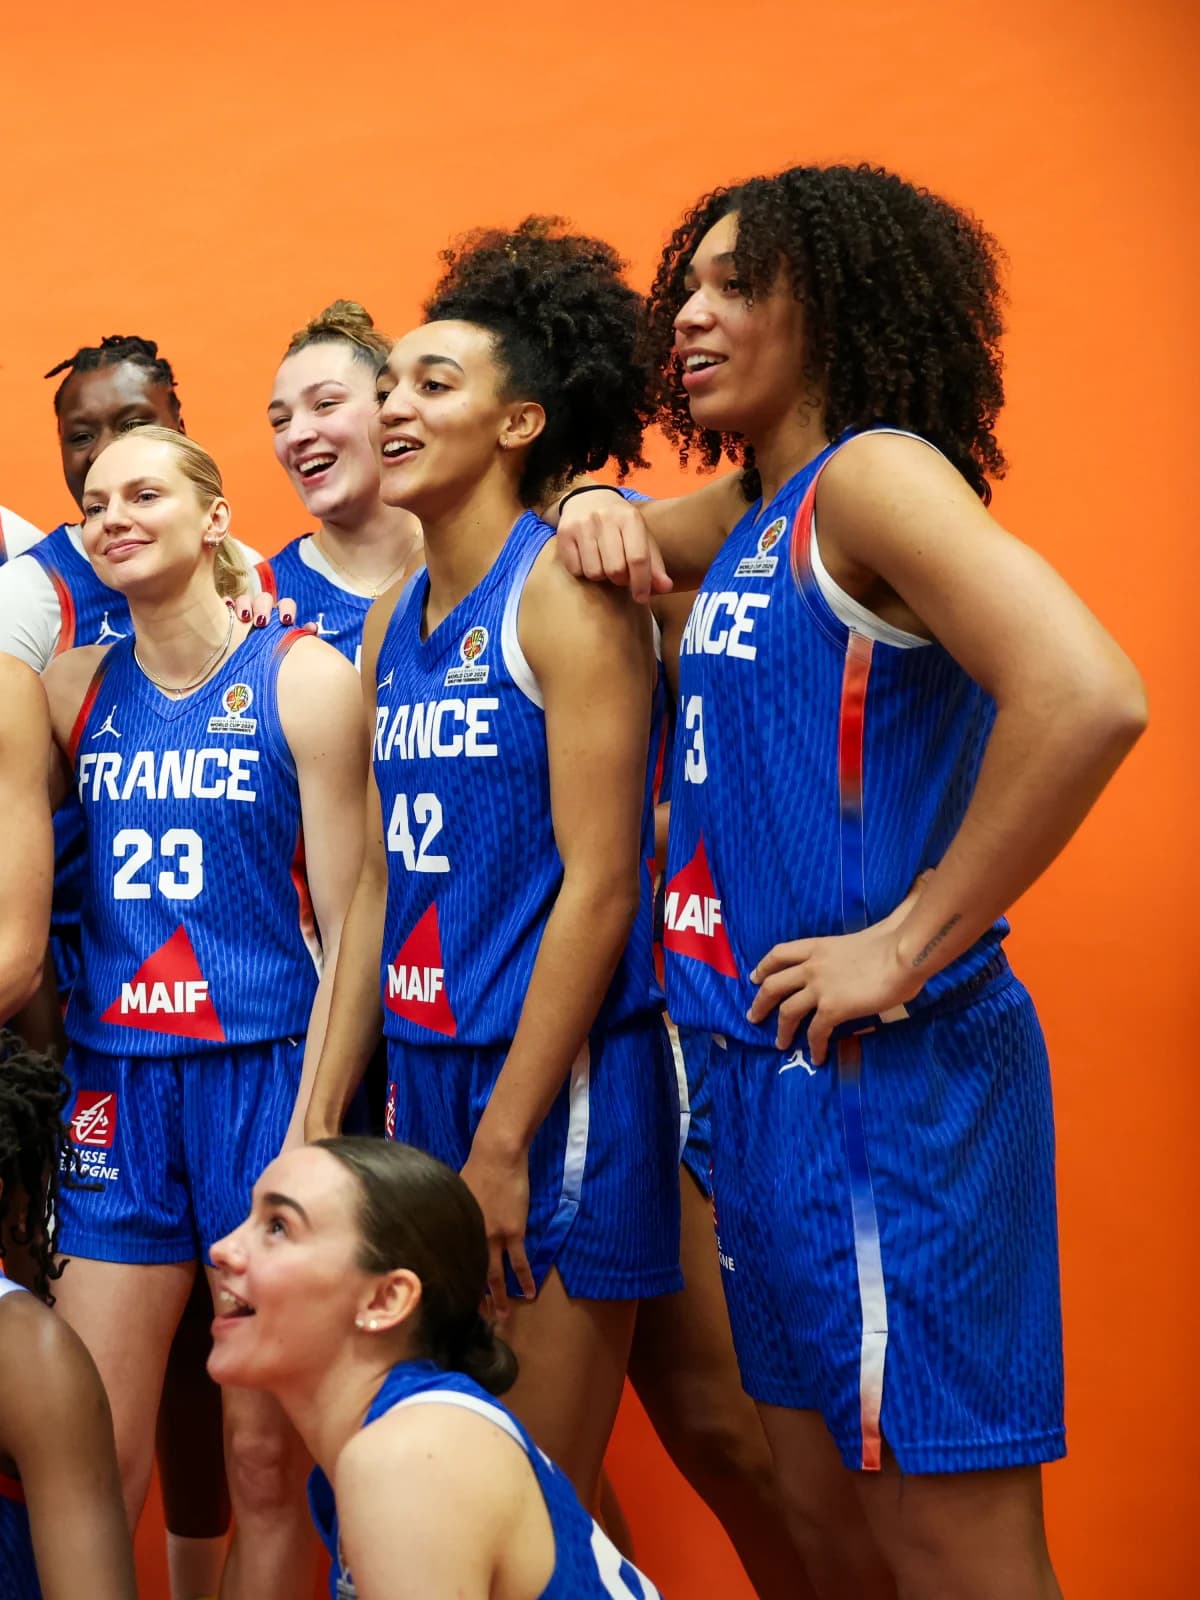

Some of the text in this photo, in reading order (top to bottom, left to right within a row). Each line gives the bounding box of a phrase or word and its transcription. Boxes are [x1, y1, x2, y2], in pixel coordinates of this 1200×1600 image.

[680, 591, 771, 661] ANCE
[373, 698, 499, 761] RANCE
[681, 695, 708, 784] 3
[78, 748, 260, 804] FRANCE
[112, 828, 204, 900] 23
[387, 793, 450, 873] 42
[120, 981, 209, 1014] MAIF
[387, 964, 445, 1004] MAIF
